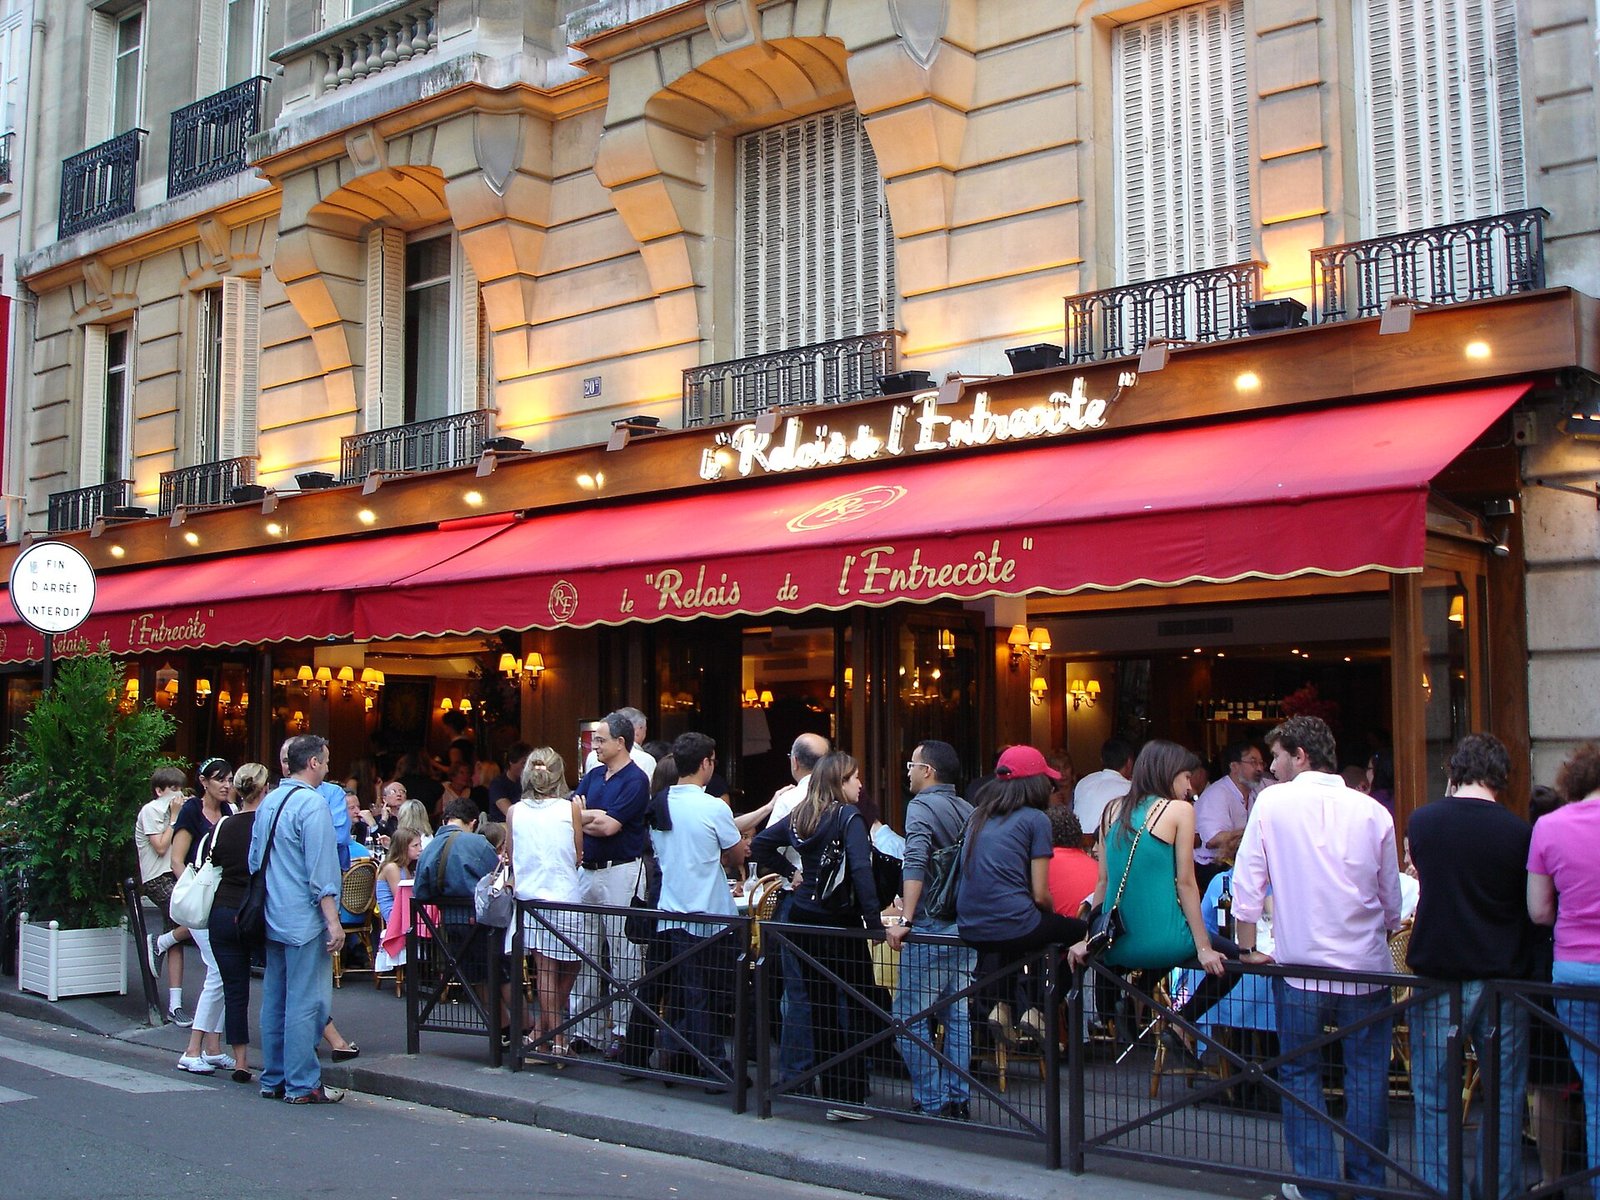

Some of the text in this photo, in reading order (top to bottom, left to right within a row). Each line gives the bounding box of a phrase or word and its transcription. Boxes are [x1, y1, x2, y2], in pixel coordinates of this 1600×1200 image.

[47, 559, 65, 569] FIN
[32, 580, 78, 594] DARRÊT
[620, 588, 635, 613] le
[777, 573, 799, 601] de
[27, 605, 80, 617] INTERDIT
[26, 639, 35, 656] le
